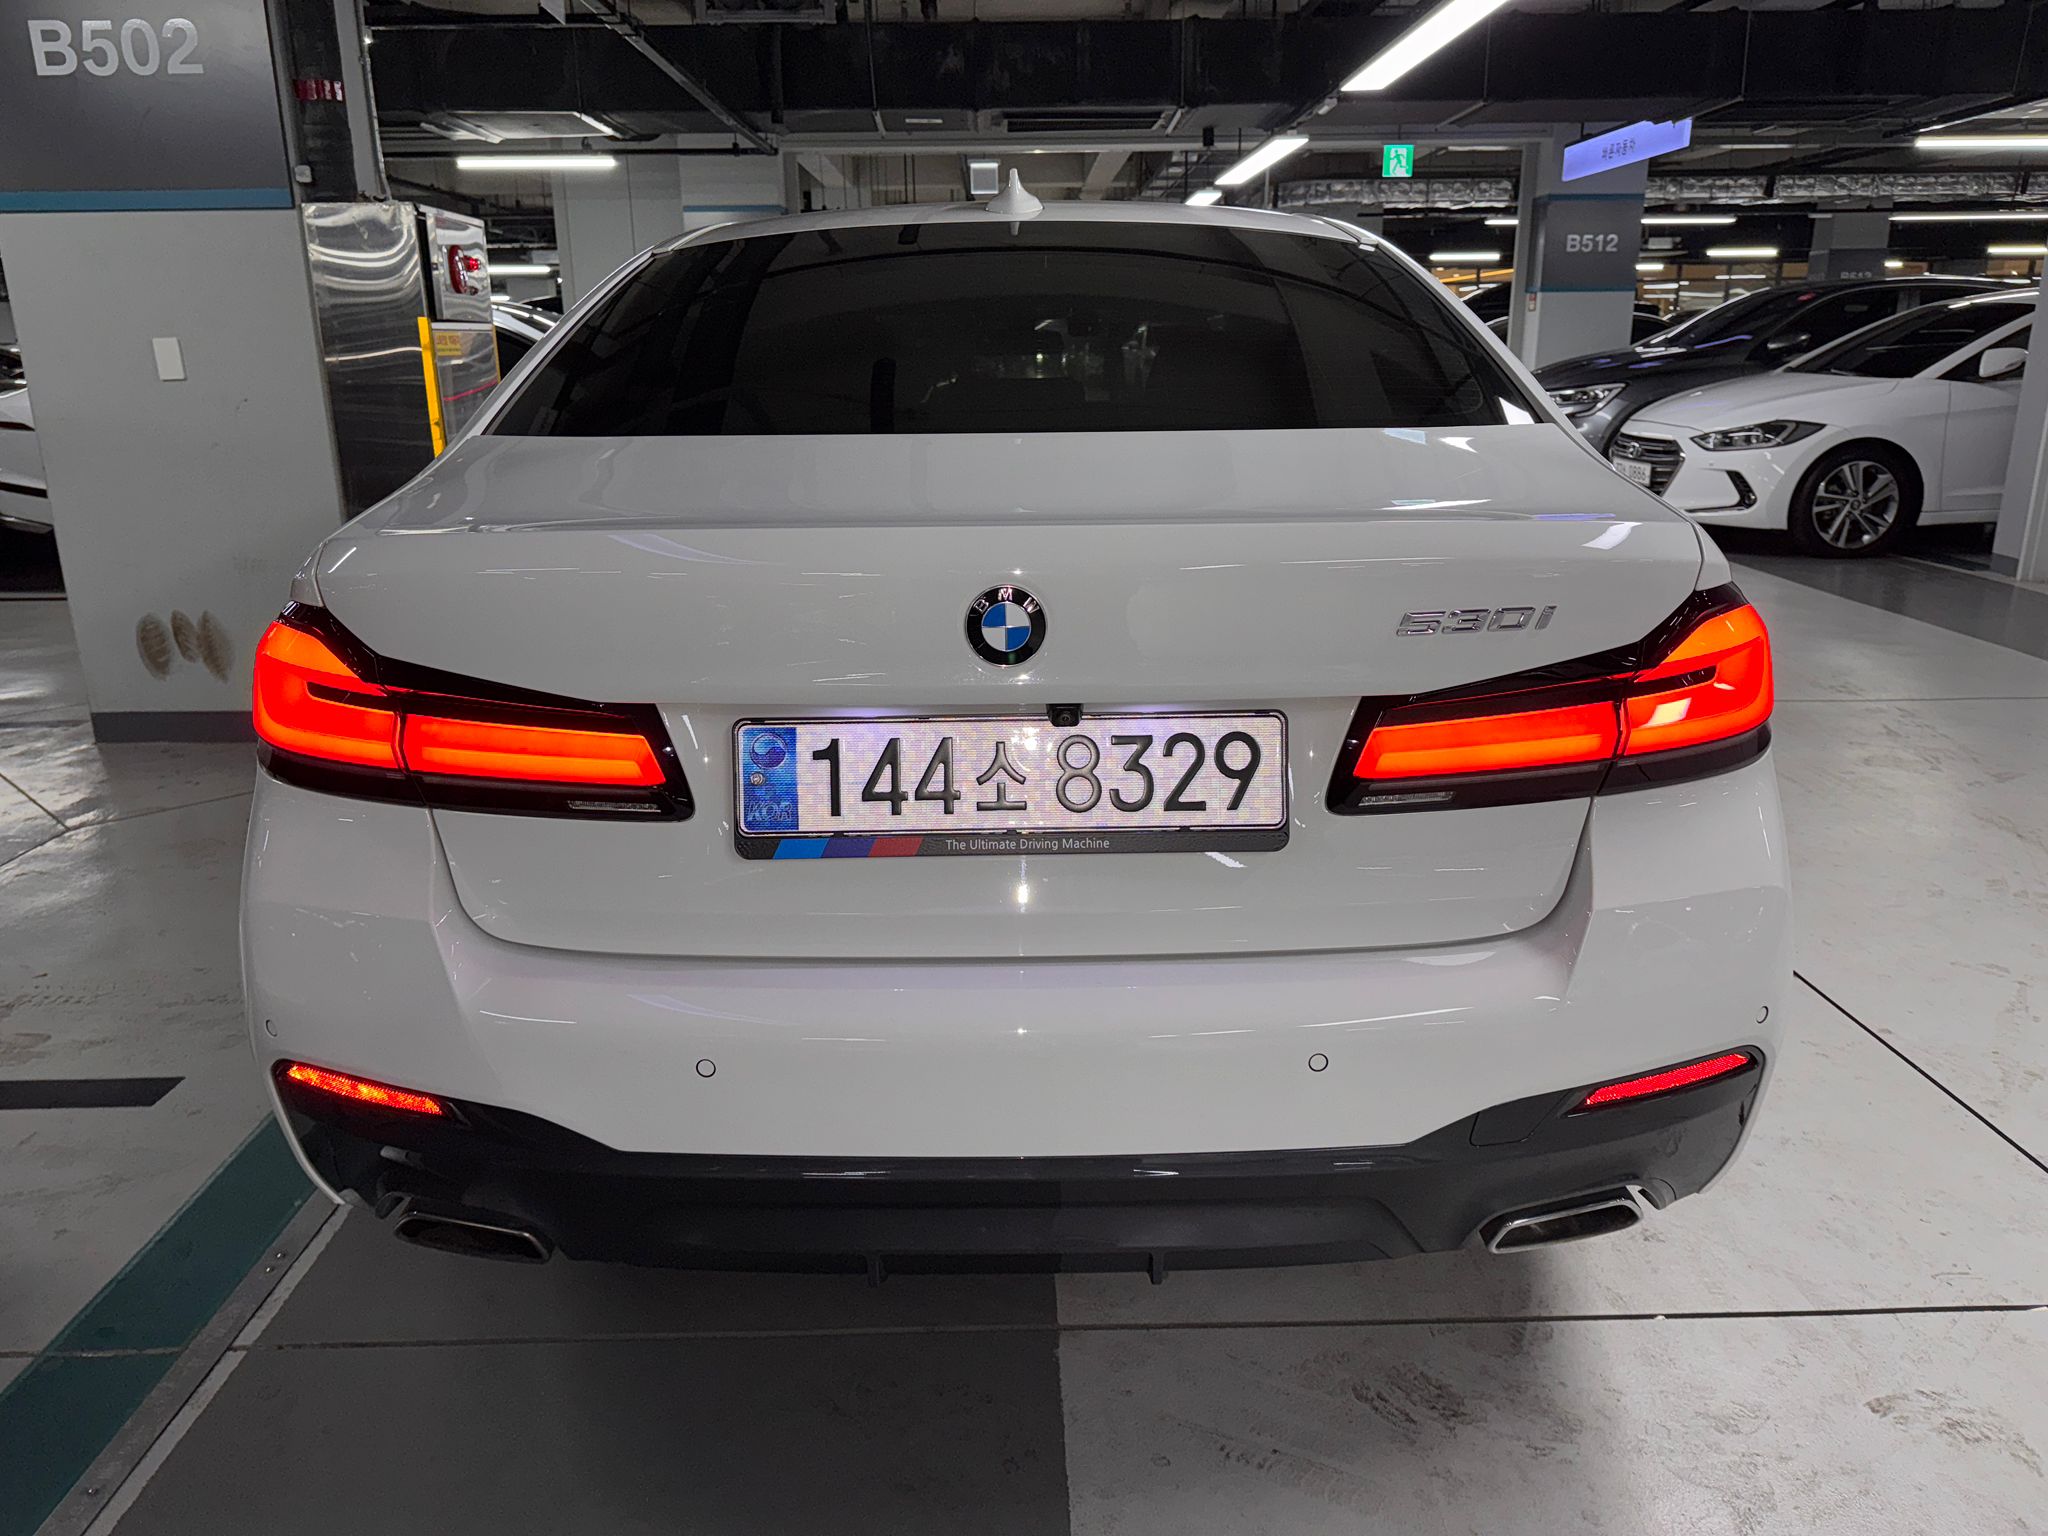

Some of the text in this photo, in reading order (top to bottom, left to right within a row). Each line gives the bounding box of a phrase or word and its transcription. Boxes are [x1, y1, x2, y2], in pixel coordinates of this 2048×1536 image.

[27, 18, 204, 76] B502
[1566, 234, 1619, 252] B512
[973, 587, 1040, 614] BMW
[813, 731, 1261, 817] 144소 8329
[747, 801, 793, 821] KOR
[946, 836, 1111, 851] The Ultimate Driving Machine
